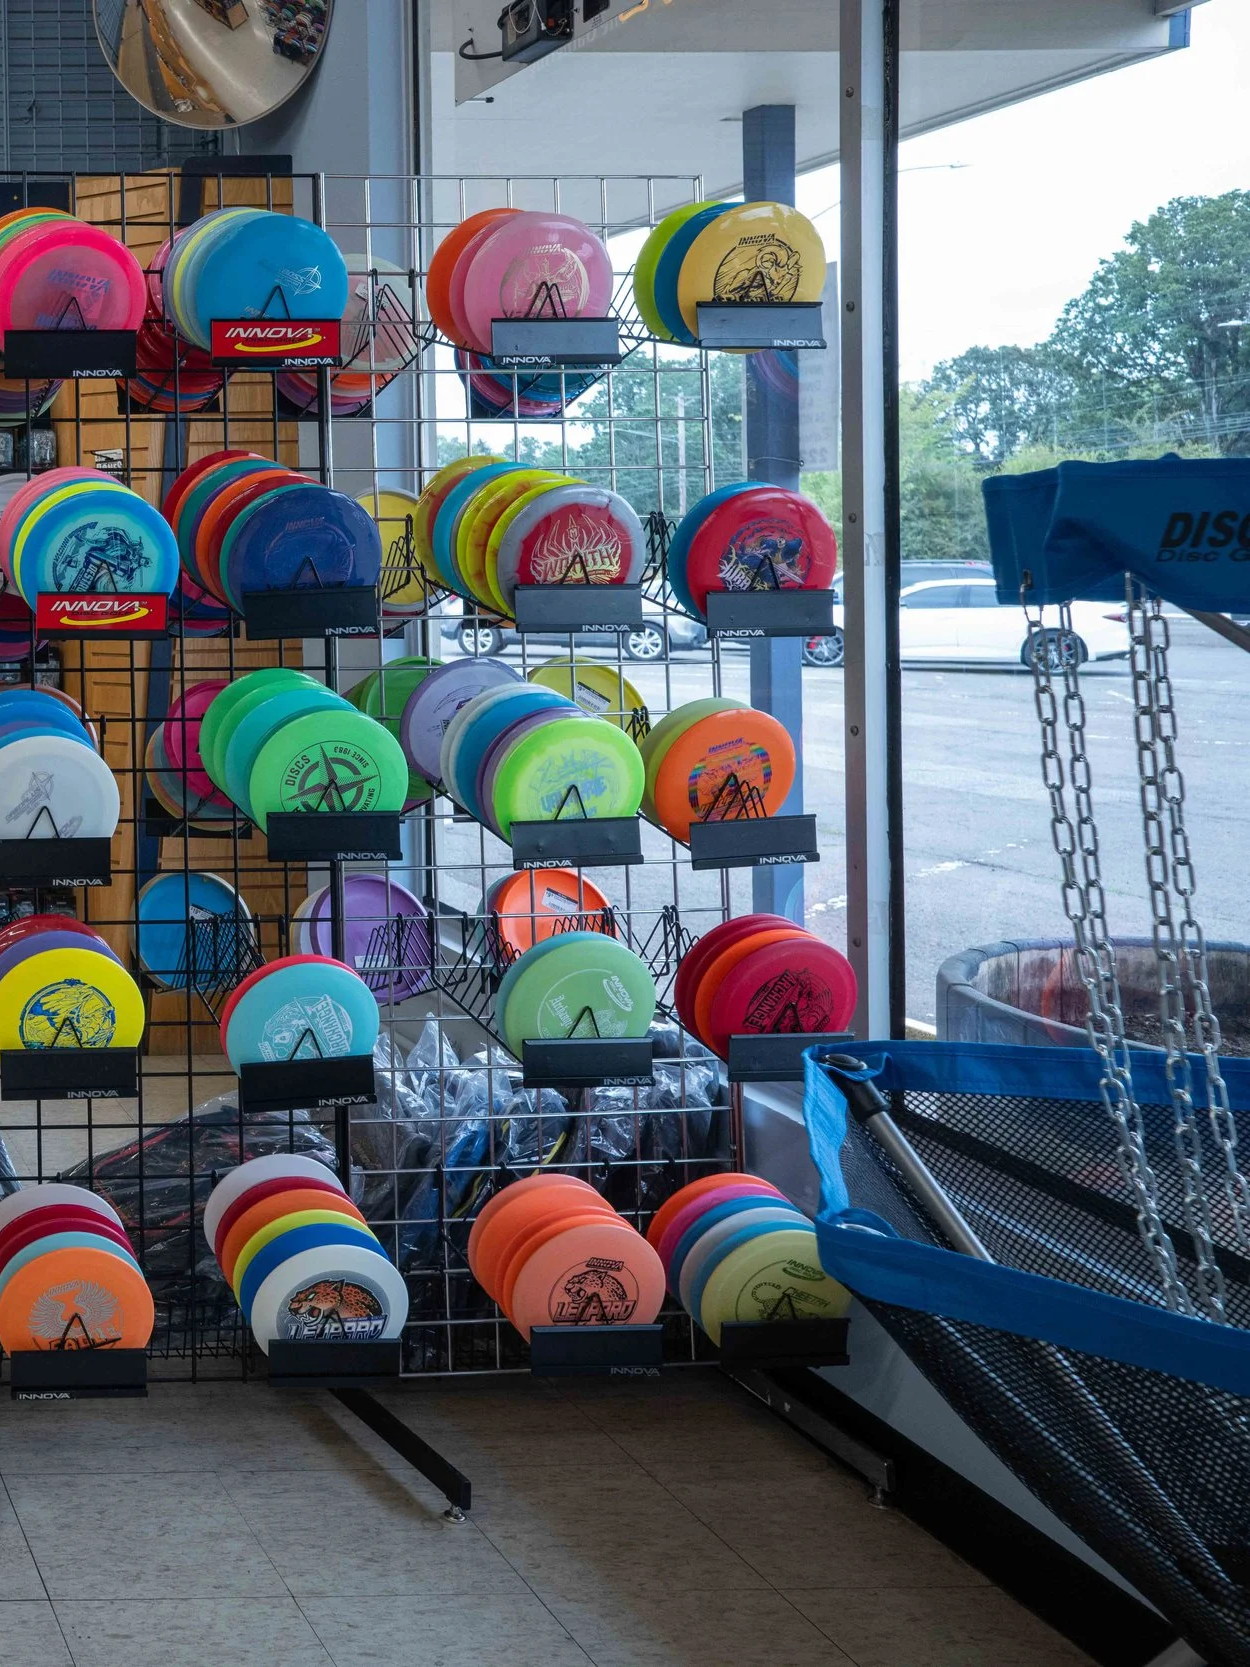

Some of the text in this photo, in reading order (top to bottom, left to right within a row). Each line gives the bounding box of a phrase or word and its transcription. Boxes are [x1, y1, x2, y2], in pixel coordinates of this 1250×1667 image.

[738, 233, 776, 246] INNOVA
[225, 327, 313, 338] INNOVA
[773, 338, 821, 348] INNOVA
[284, 357, 334, 366] INNOVA
[502, 355, 551, 364] INNOVA
[72, 369, 123, 377] INNOVA
[284, 516, 325, 531] INNOVA
[53, 536, 70, 562] INNOVA
[51, 600, 140, 612] INNOVA
[325, 625, 376, 635] INNOVA
[581, 624, 631, 632] INNOVA
[715, 628, 765, 637] INNOVA
[707, 737, 745, 754] INNOVA
[333, 745, 370, 769] SINCE 1983
[284, 754, 311, 787] DISCS
[336, 851, 388, 860] INNOVA
[759, 854, 808, 864] INNOVA
[522, 859, 573, 868] INNOVA
[52, 877, 104, 886] INNOVA
[607, 974, 637, 1006] INNOVA
[743, 967, 796, 1036] ARCHANGEL
[308, 994, 349, 1057] ARCHANGEL
[603, 1076, 653, 1086] INNOVA
[67, 1089, 119, 1099] INNOVA
[318, 1096, 370, 1106] INNOVA
[587, 1257, 624, 1272] INNOVA
[786, 1258, 826, 1279] INNOVA
[48, 1280, 80, 1298] INNOVA
[784, 1286, 830, 1308] CHEETAH
[552, 1299, 637, 1324] LEOPARD
[287, 1313, 388, 1340] LEOPARD
[610, 1366, 660, 1376] INNOVA
[18, 1392, 71, 1400] INNOVA
